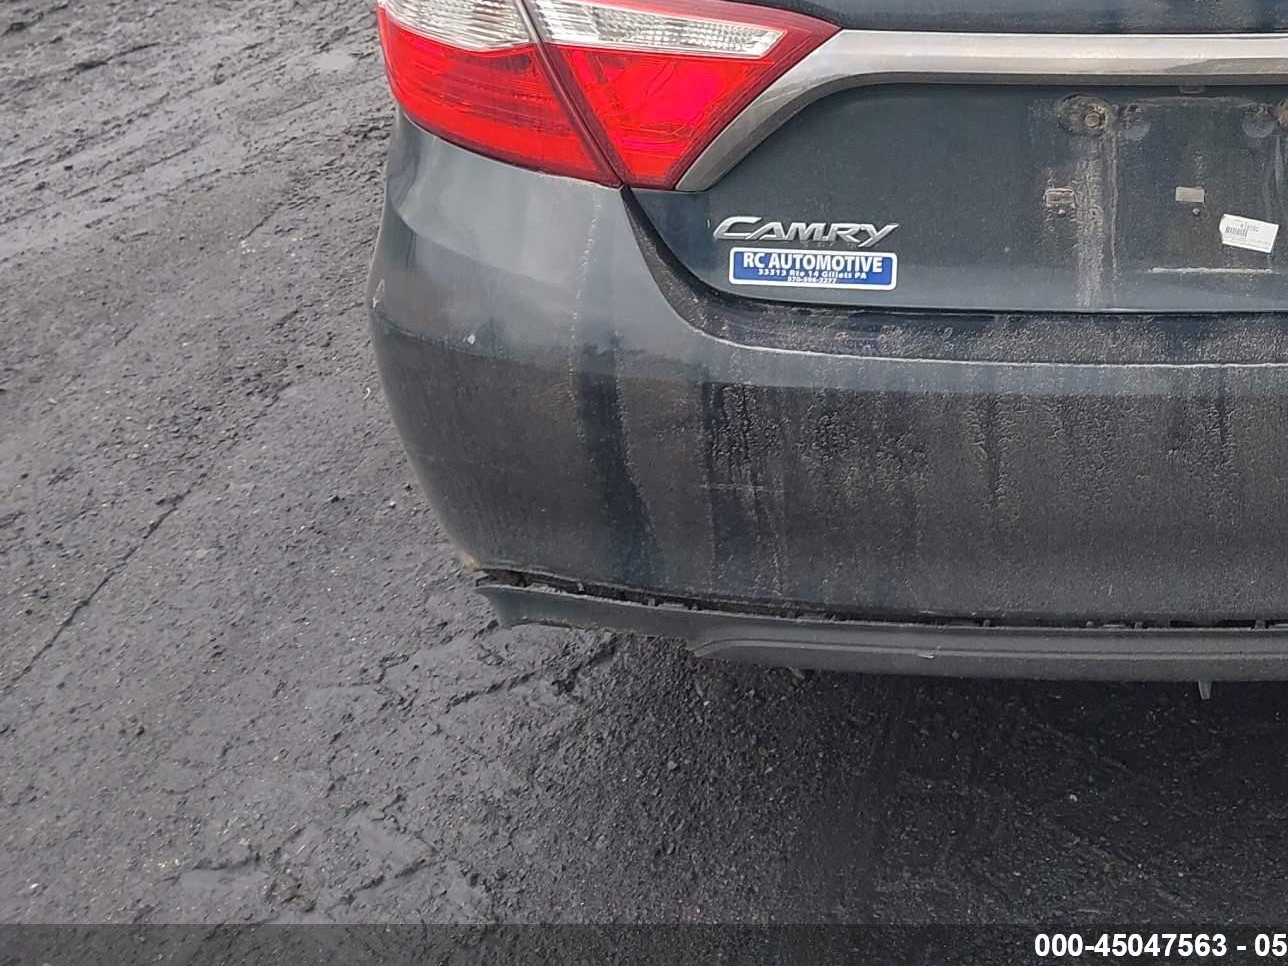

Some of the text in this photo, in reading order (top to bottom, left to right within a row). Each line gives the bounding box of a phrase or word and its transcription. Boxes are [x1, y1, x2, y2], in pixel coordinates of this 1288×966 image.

[743, 252, 883, 273] RC AUTOMOTIVE
[854, 272, 867, 280] PA
